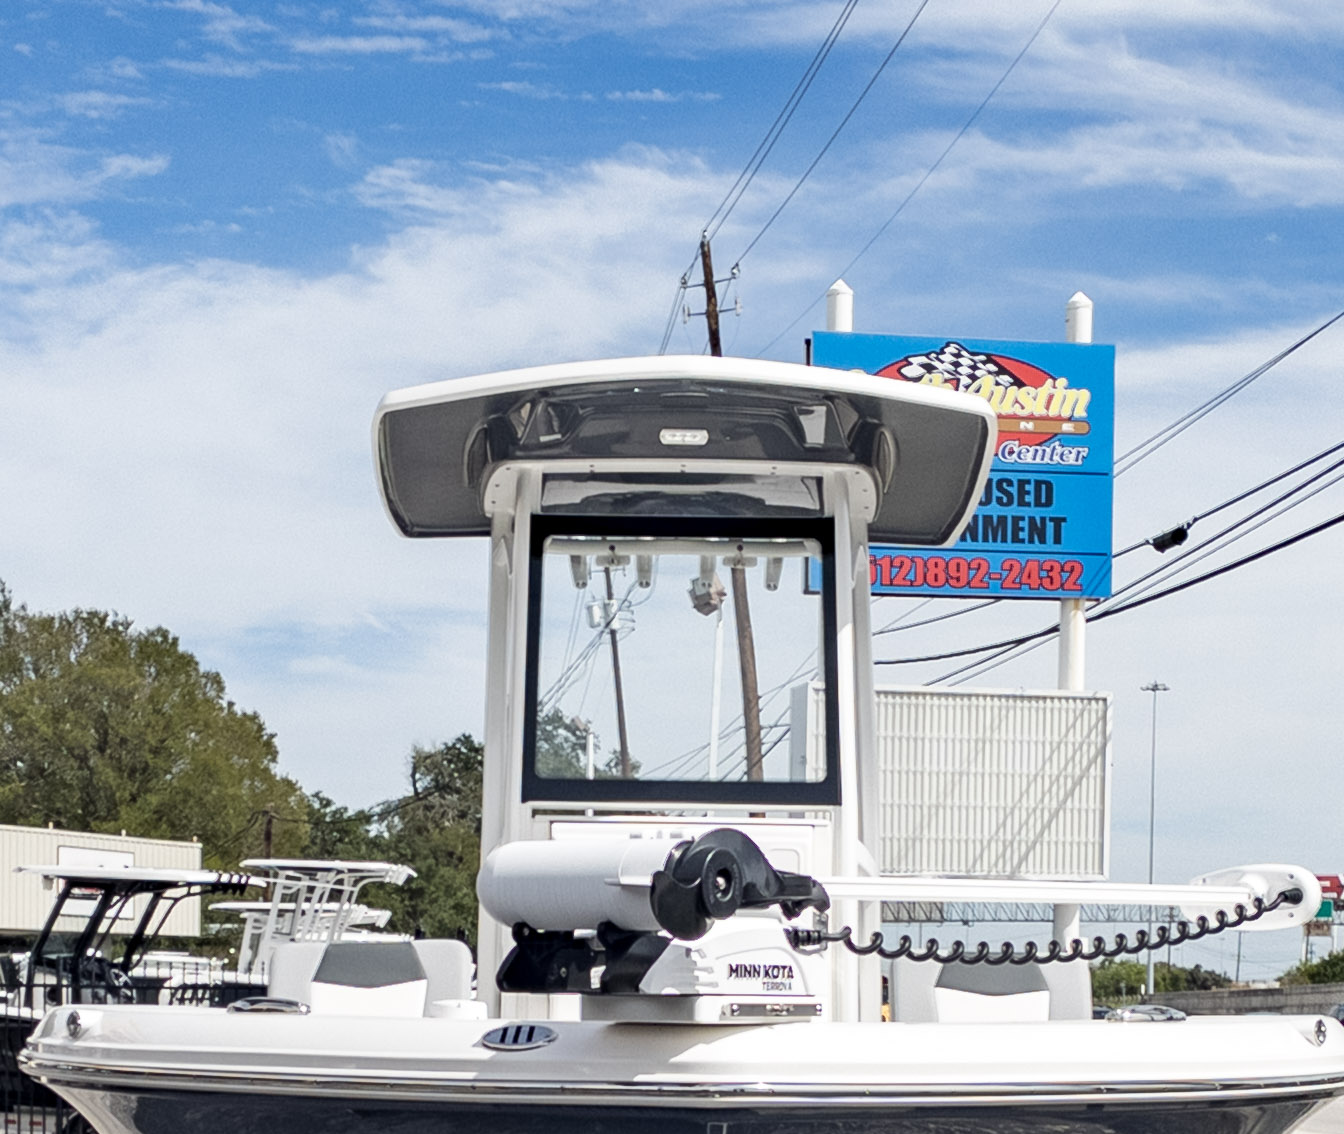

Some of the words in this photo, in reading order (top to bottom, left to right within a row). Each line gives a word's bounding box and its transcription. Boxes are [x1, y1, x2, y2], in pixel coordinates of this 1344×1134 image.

[998, 439, 1089, 465] Center
[728, 963, 761, 979] MINN
[763, 964, 795, 979] KOTA
